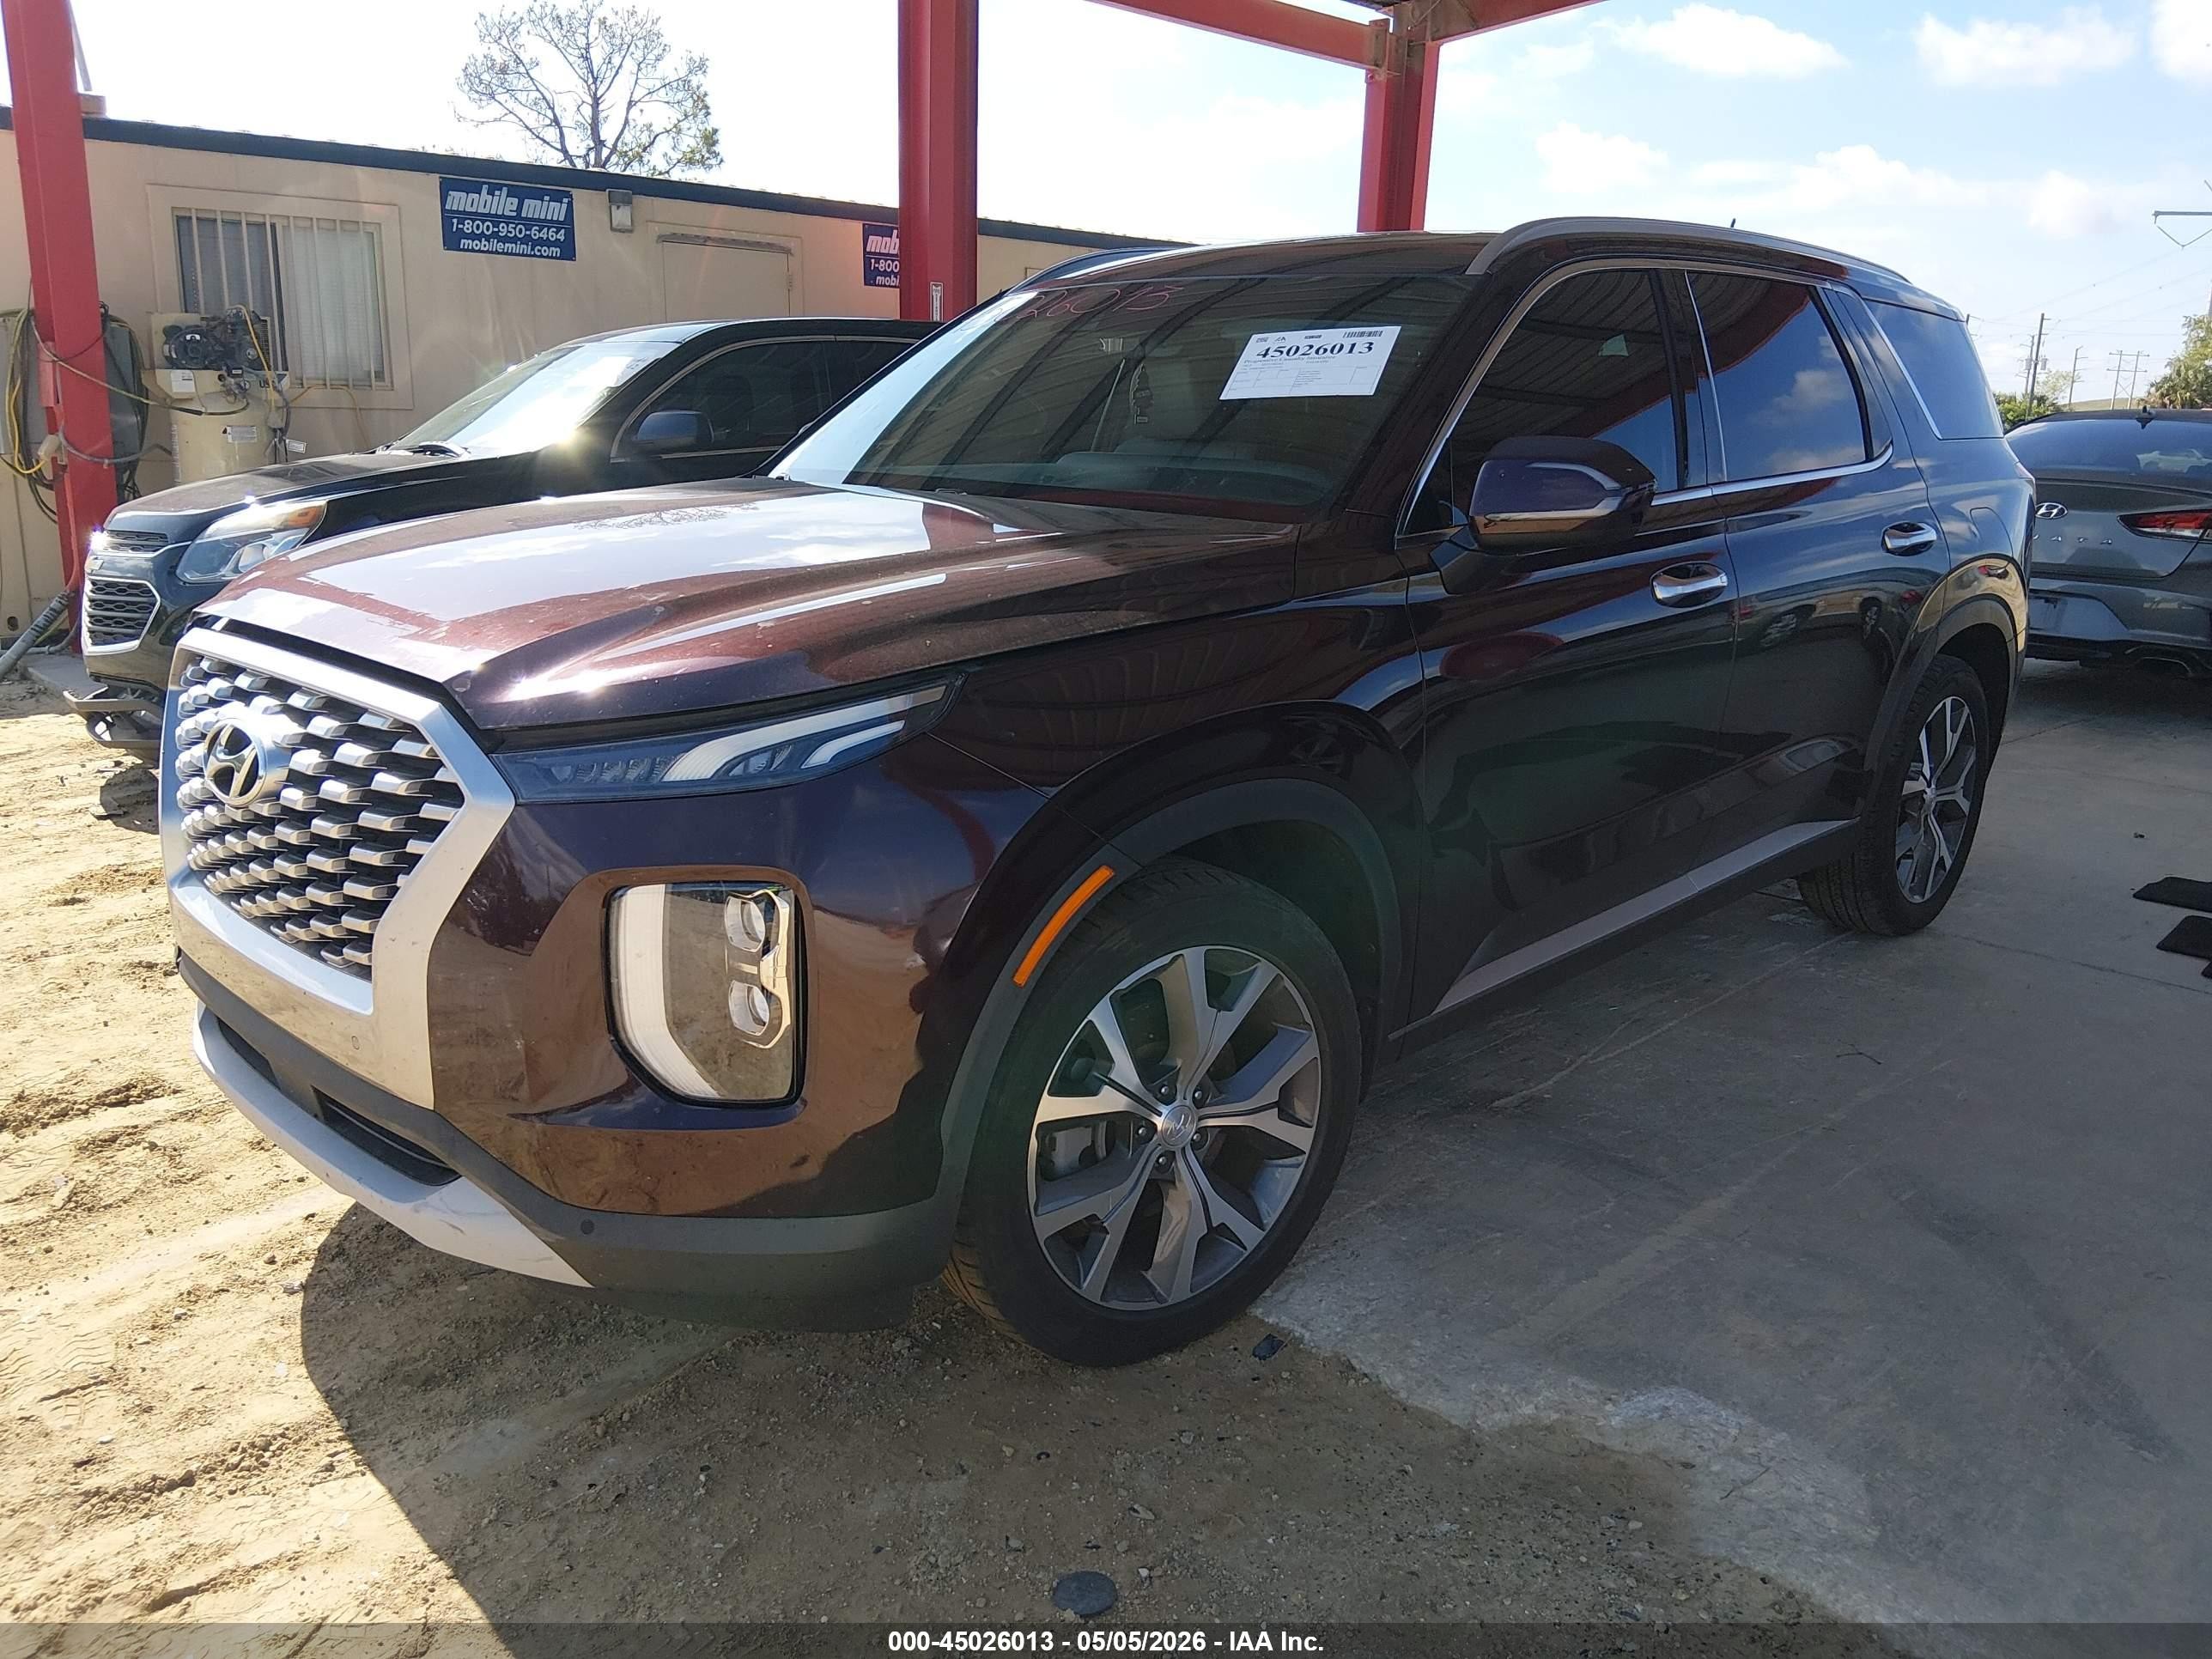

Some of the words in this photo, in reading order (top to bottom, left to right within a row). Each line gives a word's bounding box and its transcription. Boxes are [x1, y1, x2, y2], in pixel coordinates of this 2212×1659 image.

[445, 184, 519, 216] mobile
[520, 195, 568, 221] mini
[451, 217, 565, 242] 1-800-950-6464
[866, 229, 900, 255] mob
[459, 237, 561, 258] mobilemini.com
[1256, 341, 1375, 359] 45026013
